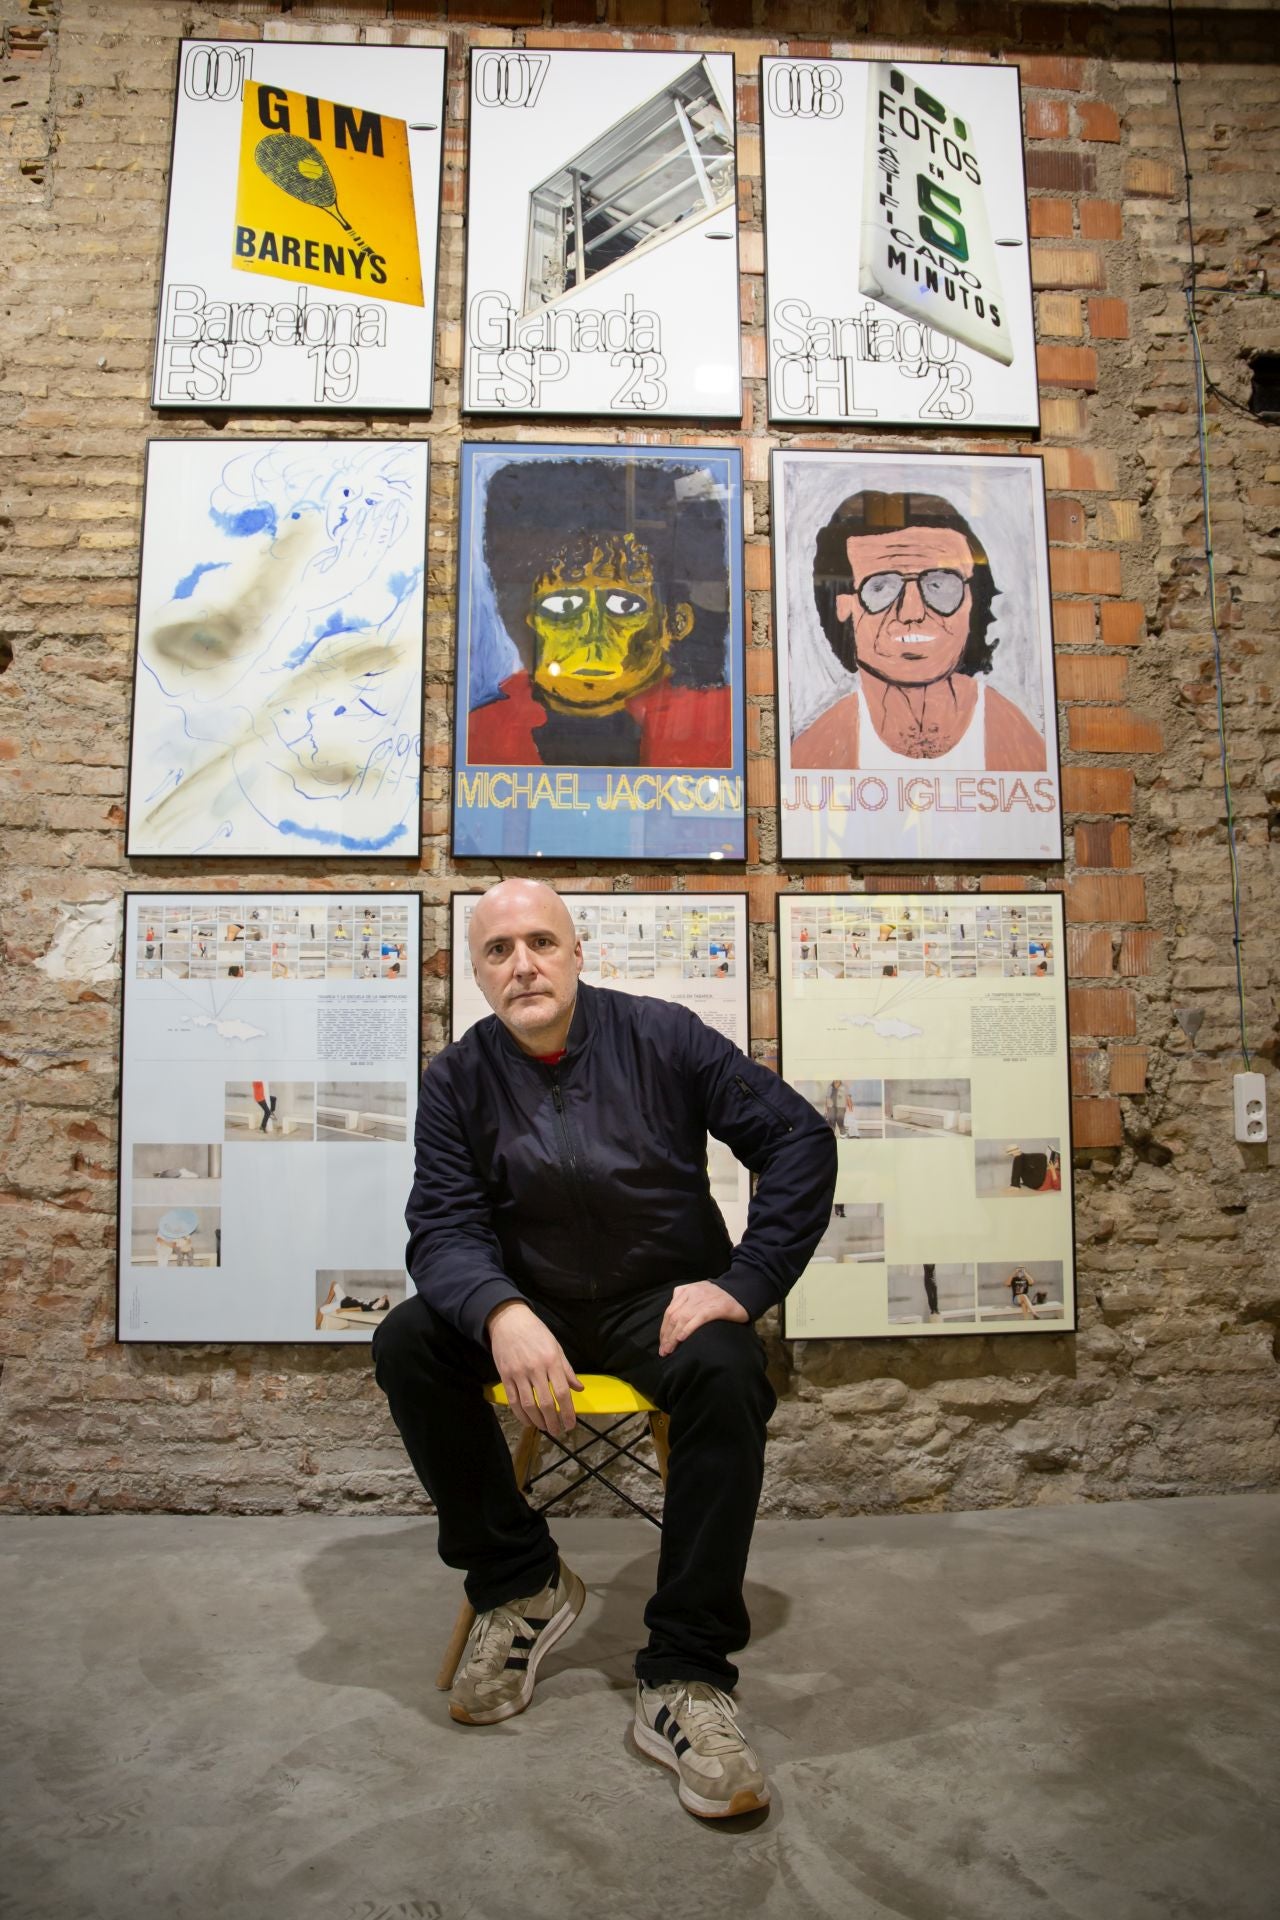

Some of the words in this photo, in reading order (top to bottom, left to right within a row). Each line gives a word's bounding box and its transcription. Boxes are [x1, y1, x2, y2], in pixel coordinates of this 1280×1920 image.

[184, 44, 254, 101] 001
[475, 52, 551, 108] 007
[767, 62, 844, 120] 008
[257, 85, 385, 157] GIM
[879, 90, 982, 186] FOTOS
[929, 162, 945, 181] EN
[163, 283, 388, 348] Barcelona
[887, 244, 1001, 328] MINUTOS
[469, 289, 662, 355] Granada
[772, 297, 957, 379] Santiago
[159, 338, 263, 402] ESP
[307, 343, 360, 403] 19
[468, 345, 570, 409] ESP
[610, 350, 668, 411] 23
[773, 353, 878, 418] CHL
[918, 359, 974, 421] 23
[457, 771, 591, 810] MICHAEL
[596, 773, 742, 812] JACKSON
[783, 775, 889, 812] JULIO
[897, 776, 1056, 813] IGLESIAS
